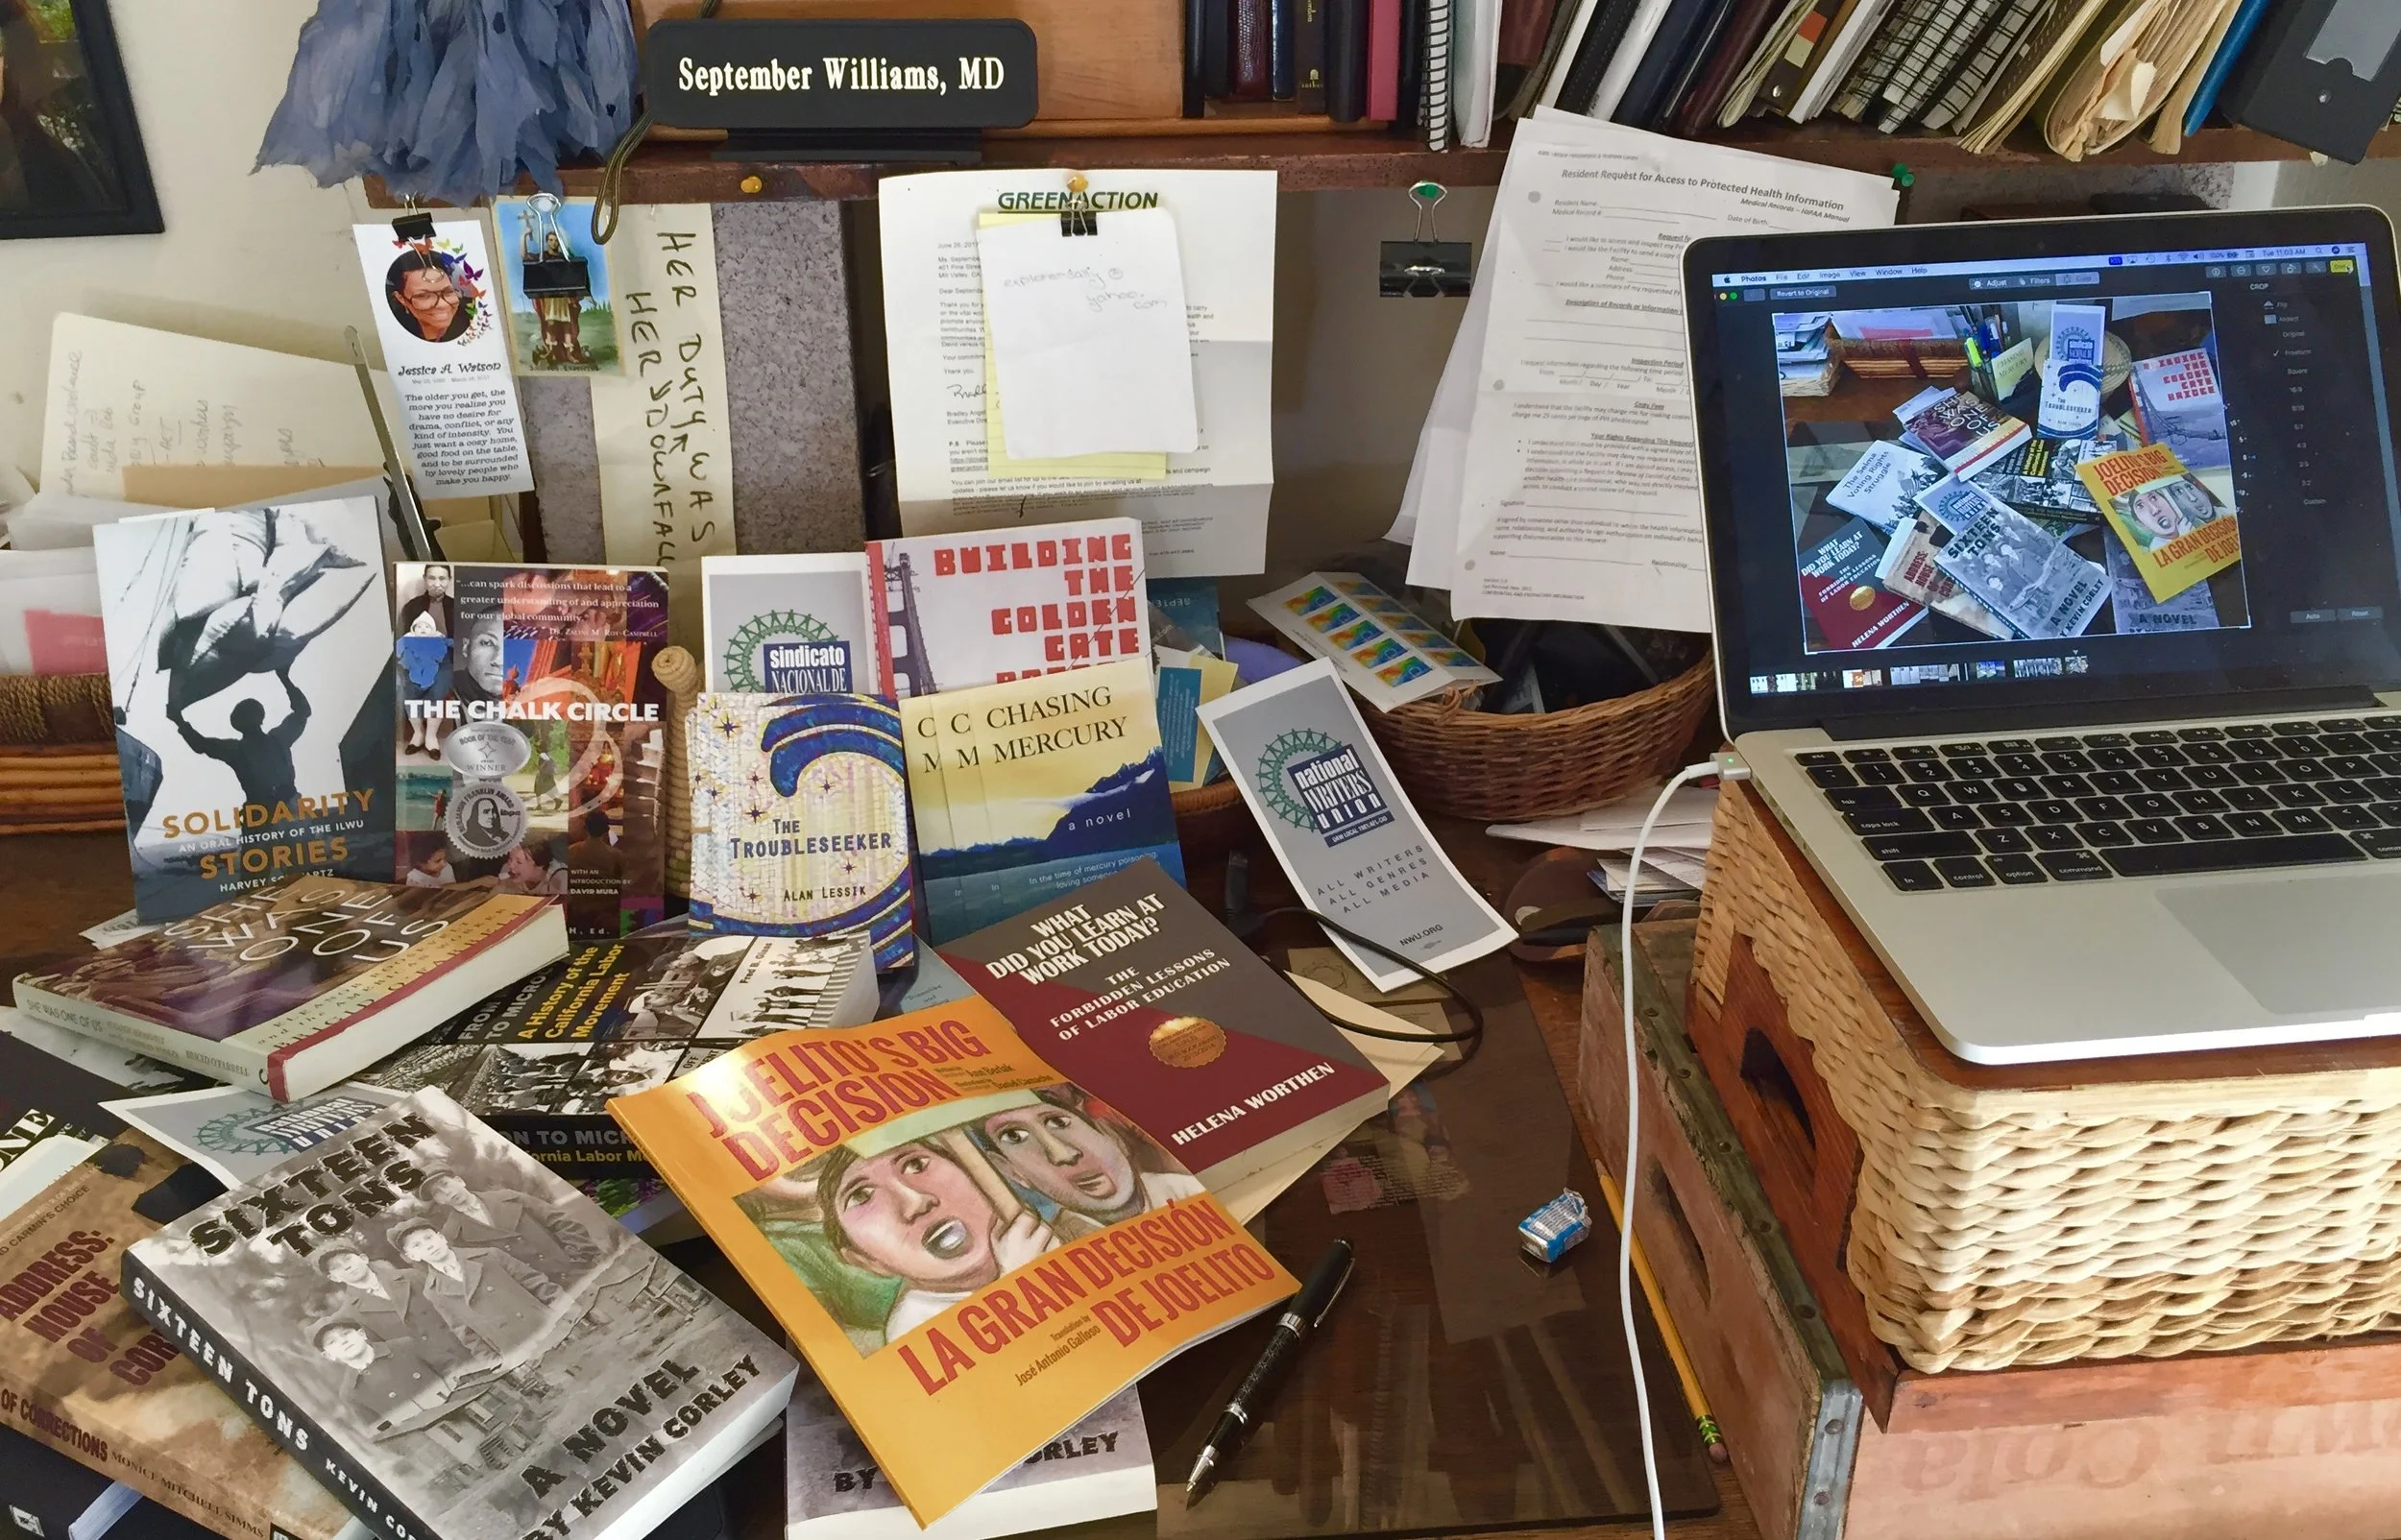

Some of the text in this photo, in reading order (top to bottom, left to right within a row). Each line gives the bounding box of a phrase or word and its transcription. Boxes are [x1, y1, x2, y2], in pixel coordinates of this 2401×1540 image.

[678, 57, 1004, 96] September Williams, MD
[998, 192, 1158, 210] GREENACTION
[1562, 169, 1844, 210] Resident Request for Access to Protected Health Information
[1806, 288, 1829, 297] Original
[1819, 271, 1840, 279] Image
[625, 291, 662, 377] HER
[398, 365, 437, 376] Jessica
[457, 362, 501, 373] Watson
[656, 232, 715, 543] HER DUTY WAS
[417, 450, 439, 460] good
[476, 446, 492, 455] the
[493, 445, 519, 453] table,
[934, 532, 1133, 577] BUILDING
[1948, 507, 1999, 559] SIXTEEN
[1967, 522, 2001, 557] TONS
[489, 580, 516, 590] spark
[518, 580, 570, 590] discussions
[573, 583, 592, 591] that
[594, 583, 613, 591] lead
[1063, 565, 1135, 597] THE
[991, 596, 1137, 636] GOLDEN
[1852, 625, 1879, 648] HELENA
[769, 644, 846, 668] sindicato
[1044, 627, 1140, 662] GATE
[770, 667, 847, 693] NACIONAL DE
[404, 700, 660, 721] THE CHALK CIRCLE
[986, 686, 1112, 730] CHASING
[993, 715, 1129, 764] MERCURY
[1295, 748, 1359, 790] national
[162, 788, 375, 838] SOLIDARITY
[1302, 769, 1373, 815] WRITERS
[1317, 792, 1382, 830] union
[179, 820, 364, 854] AN ORAL HISTORY OF THE ILWU
[773, 817, 800, 835] THE
[1068, 807, 1132, 831] a novel
[200, 836, 349, 880] STORIES
[729, 831, 892, 860] TROUBLESEEKER
[220, 878, 266, 893] HARVEY
[1317, 844, 1425, 897] ALL WRITERS
[1328, 857, 1429, 906] ALL GENRES
[1342, 871, 1430, 914] ALL MEDIA
[1953, 873, 1984, 881] control
[2005, 869, 2034, 878] option
[163, 885, 293, 940] SHE
[783, 885, 867, 902] ALAN LESSIK
[186, 889, 346, 950] WAS
[239, 890, 393, 960] ONE
[312, 911, 397, 956] OF
[352, 920, 449, 961] US
[985, 893, 1165, 979] DID YOU LEARN AT
[1031, 903, 1091, 938] WHAT
[1398, 923, 1443, 948] NWU.ORG
[1017, 916, 1160, 985] WORK TODAY?
[517, 947, 598, 1039] A History of the
[545, 944, 624, 1038] California Labor
[739, 969, 756, 983] Fred
[1050, 949, 1215, 1027] FORBIDDEN LESSONS
[1104, 966, 1140, 985] THE
[570, 973, 630, 1038] Movement
[1058, 958, 1231, 1041] OF LABOR EDUCATION
[686, 1020, 992, 1139] JOELITO'S BIG
[721, 1068, 961, 1181] DECISION
[1171, 1062, 1335, 1145] HELENA WORTHEN
[188, 1111, 437, 1257] SIXTEEN
[266, 1159, 426, 1258] TONS
[0, 1229, 114, 1322] ADDRESS:
[897, 1197, 1236, 1396] LA GRAN DECISIÓN
[1089, 1242, 1275, 1348] DE JOELITO
[23, 1271, 120, 1344] HOUSE
[65, 1325, 120, 1364] OF
[1014, 1324, 1101, 1386] José Antonio Galloso
[133, 1277, 378, 1513] SIXTEEN TONS KEVIN
[521, 1360, 700, 1500] A NOVEL
[568, 1354, 761, 1518] KEVIN CORLEY
[1, 1386, 265, 1539] OF CORRECTIONS MONICE MITCHELL SIMMS
